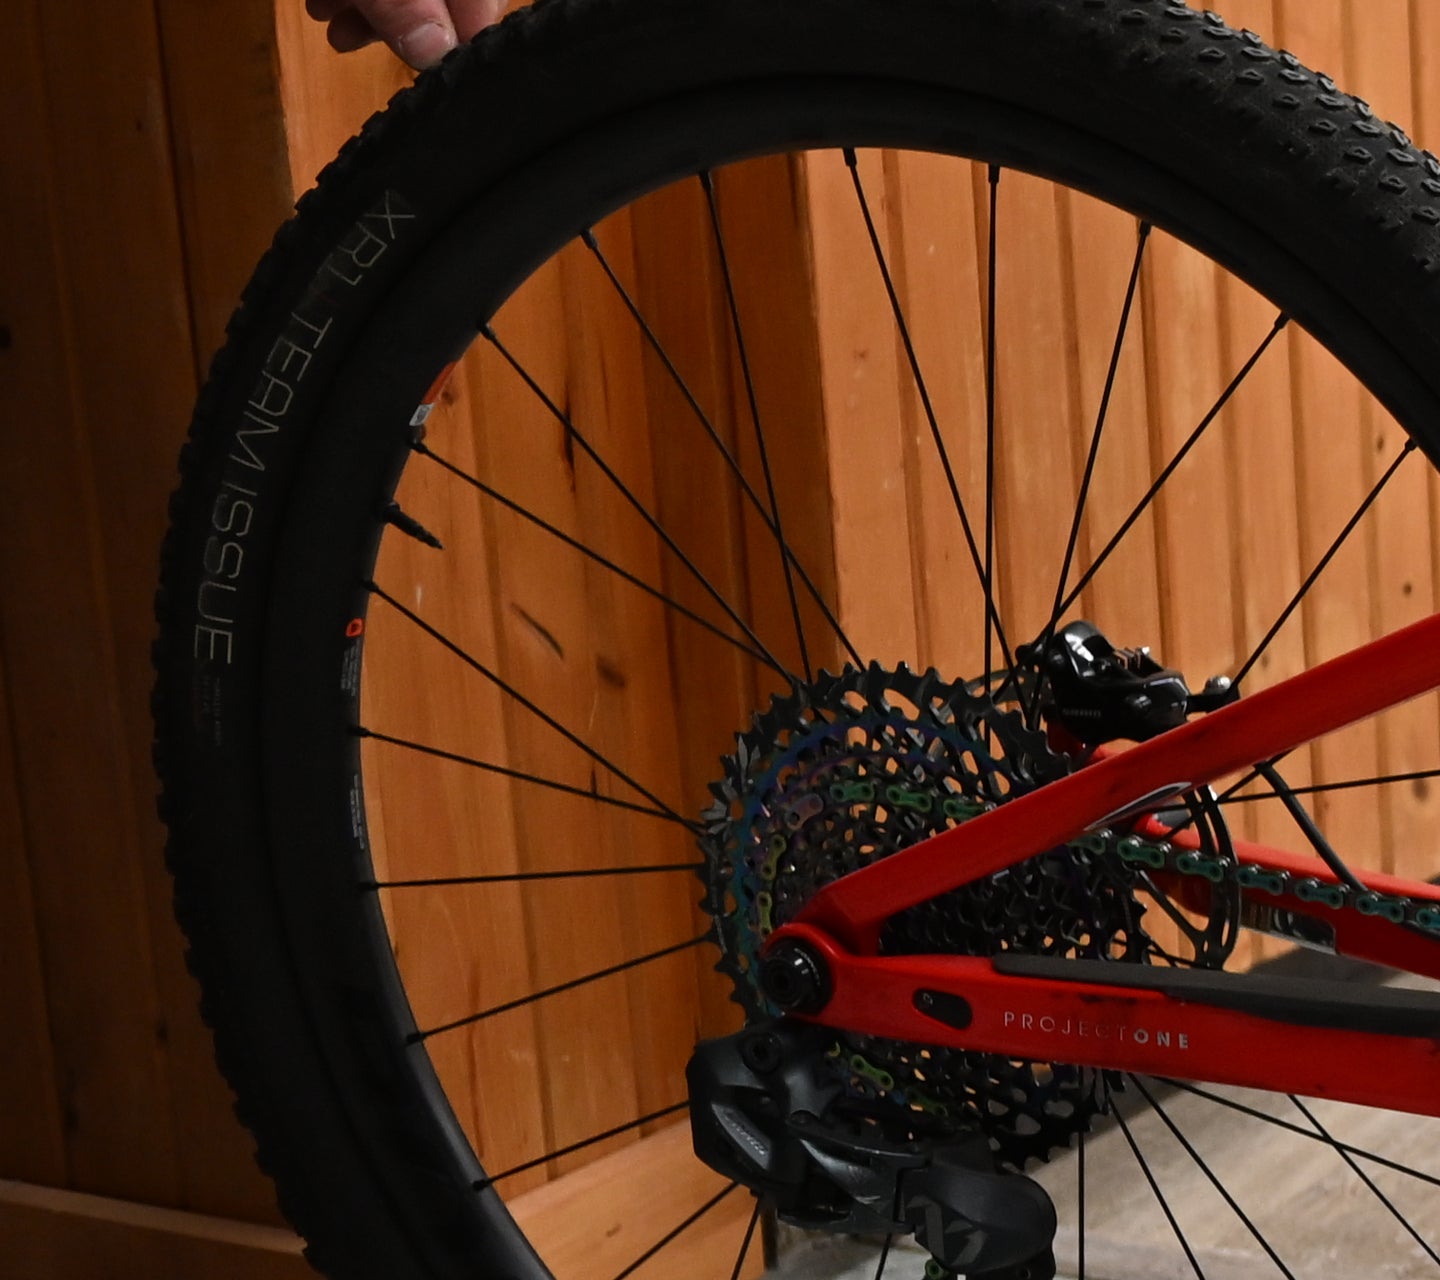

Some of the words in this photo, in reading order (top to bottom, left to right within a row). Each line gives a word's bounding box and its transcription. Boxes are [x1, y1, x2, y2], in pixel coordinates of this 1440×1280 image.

[325, 189, 415, 288] XR1
[228, 310, 333, 472] TEAM
[193, 478, 257, 664] ISSUE
